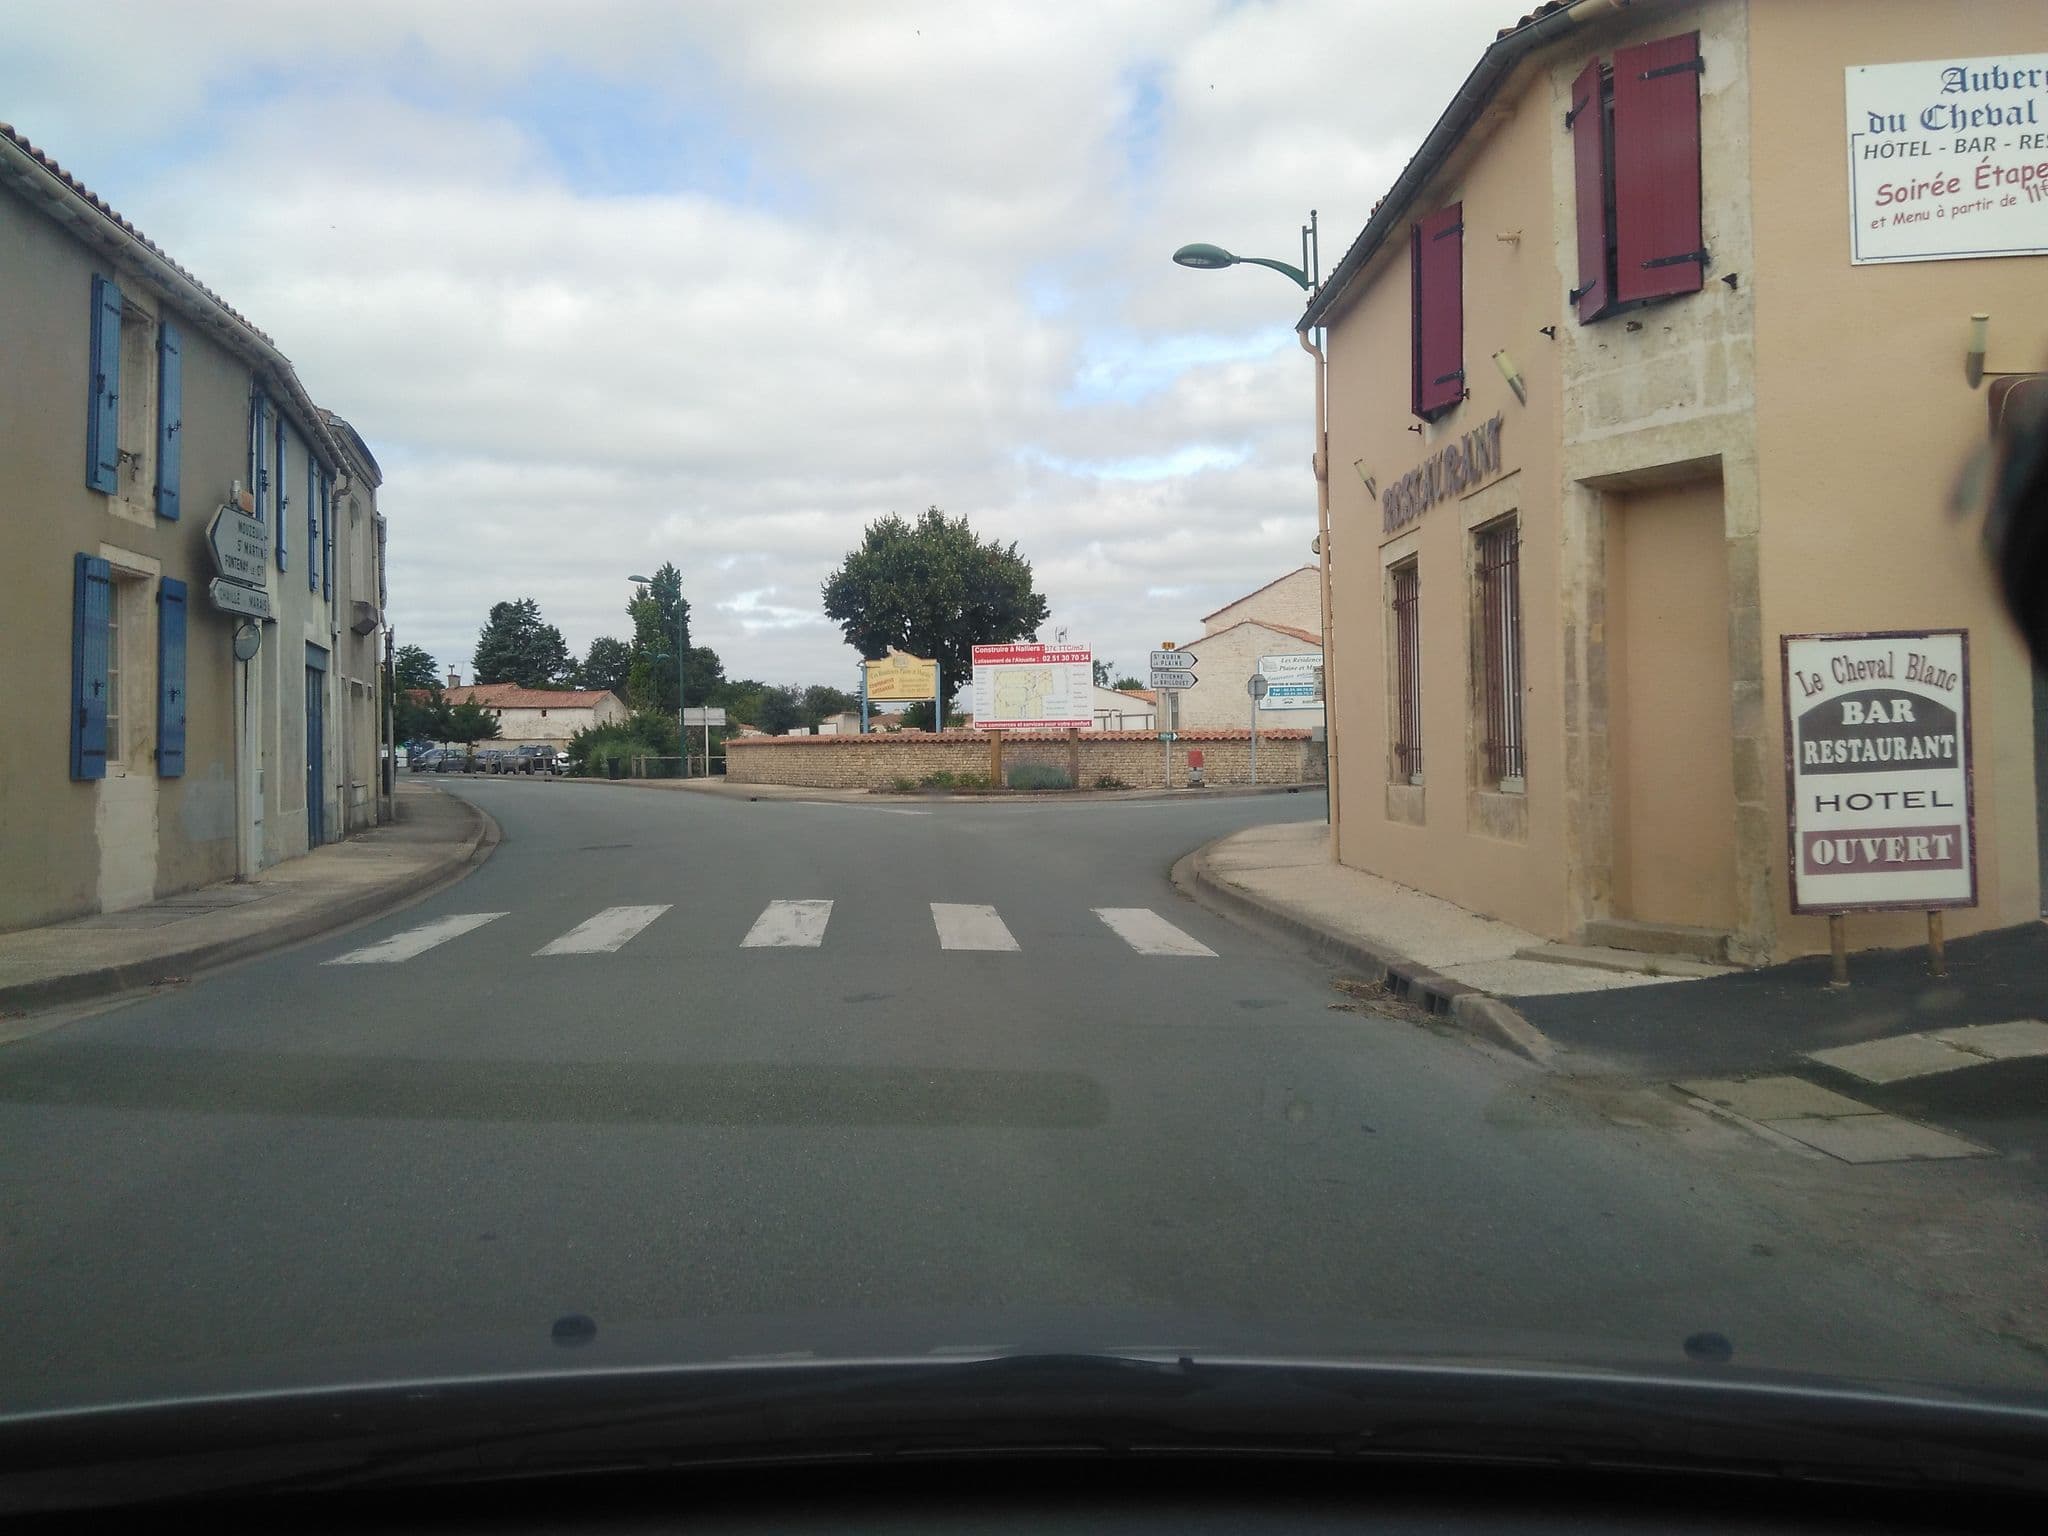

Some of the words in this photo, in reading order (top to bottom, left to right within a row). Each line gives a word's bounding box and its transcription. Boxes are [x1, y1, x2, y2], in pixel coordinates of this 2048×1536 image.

[1941, 64, 2048, 94] Auber
[1867, 111, 1907, 134] du
[1920, 98, 2039, 133] Cheval
[1864, 139, 1932, 160] HÔTEL
[1954, 136, 1996, 154] BAR
[1875, 171, 1961, 207] Soirée
[1871, 215, 1887, 230] et
[1893, 211, 1930, 226] Menu
[1936, 205, 1945, 218] à
[1952, 198, 1994, 220] partir
[2000, 194, 2017, 208] de
[1795, 669, 1823, 697] Le
[1831, 651, 1895, 684] Cheval
[1905, 652, 1958, 692] Blanc
[1841, 699, 1916, 725] BAR
[1804, 734, 1955, 764] RESTAURANT
[1815, 790, 1954, 812] HOTEL
[1812, 833, 1953, 866] OUVERT
